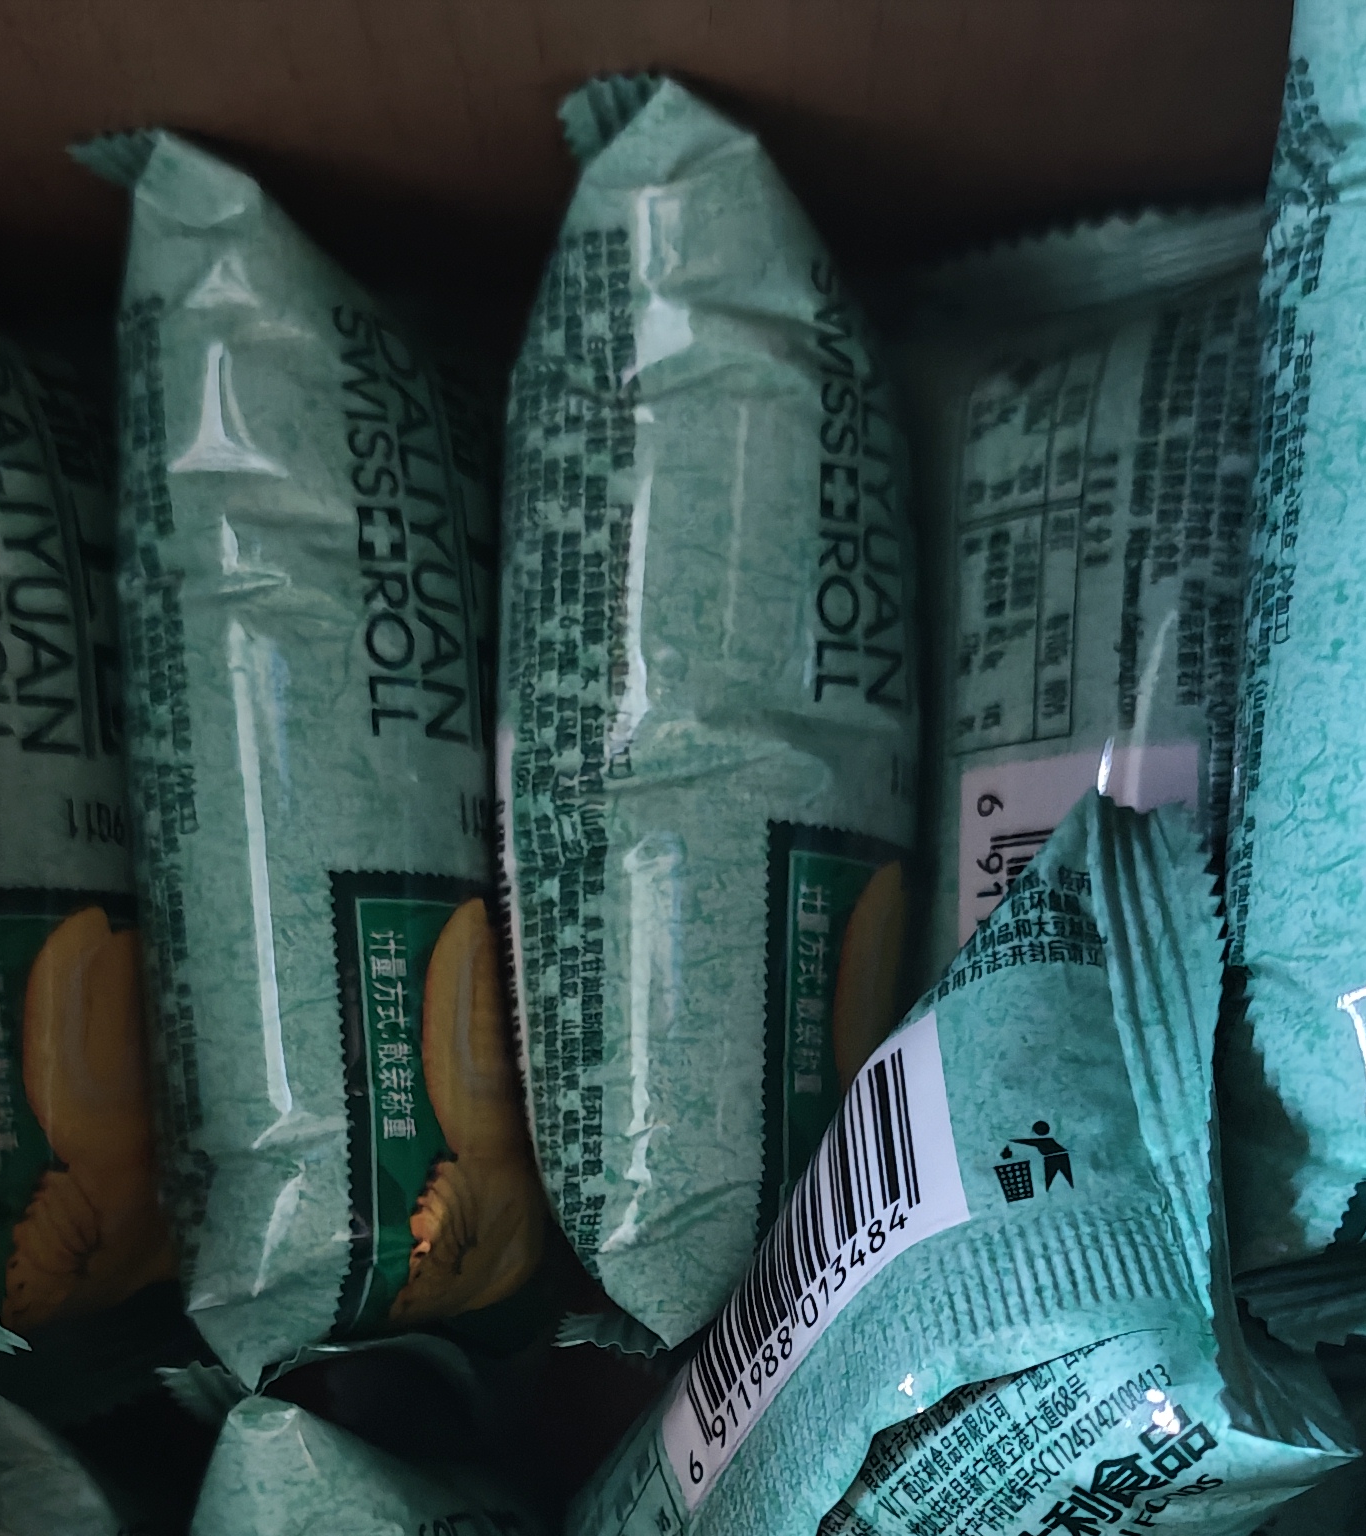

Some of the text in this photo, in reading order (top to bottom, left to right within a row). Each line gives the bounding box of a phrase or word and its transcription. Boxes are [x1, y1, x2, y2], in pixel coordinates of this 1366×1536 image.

[332, 307, 418, 736] SWISS ROLL
[374, 321, 469, 741] DALIYUAN
[814, 531, 858, 702] ROLL
[860, 345, 904, 707] ALIYUAN
[369, 931, 415, 1140] 计量方式：散装称重
[685, 1450, 707, 1485] 6
[709, 1322, 799, 1443] 911988
[801, 1203, 911, 1327] 013484
